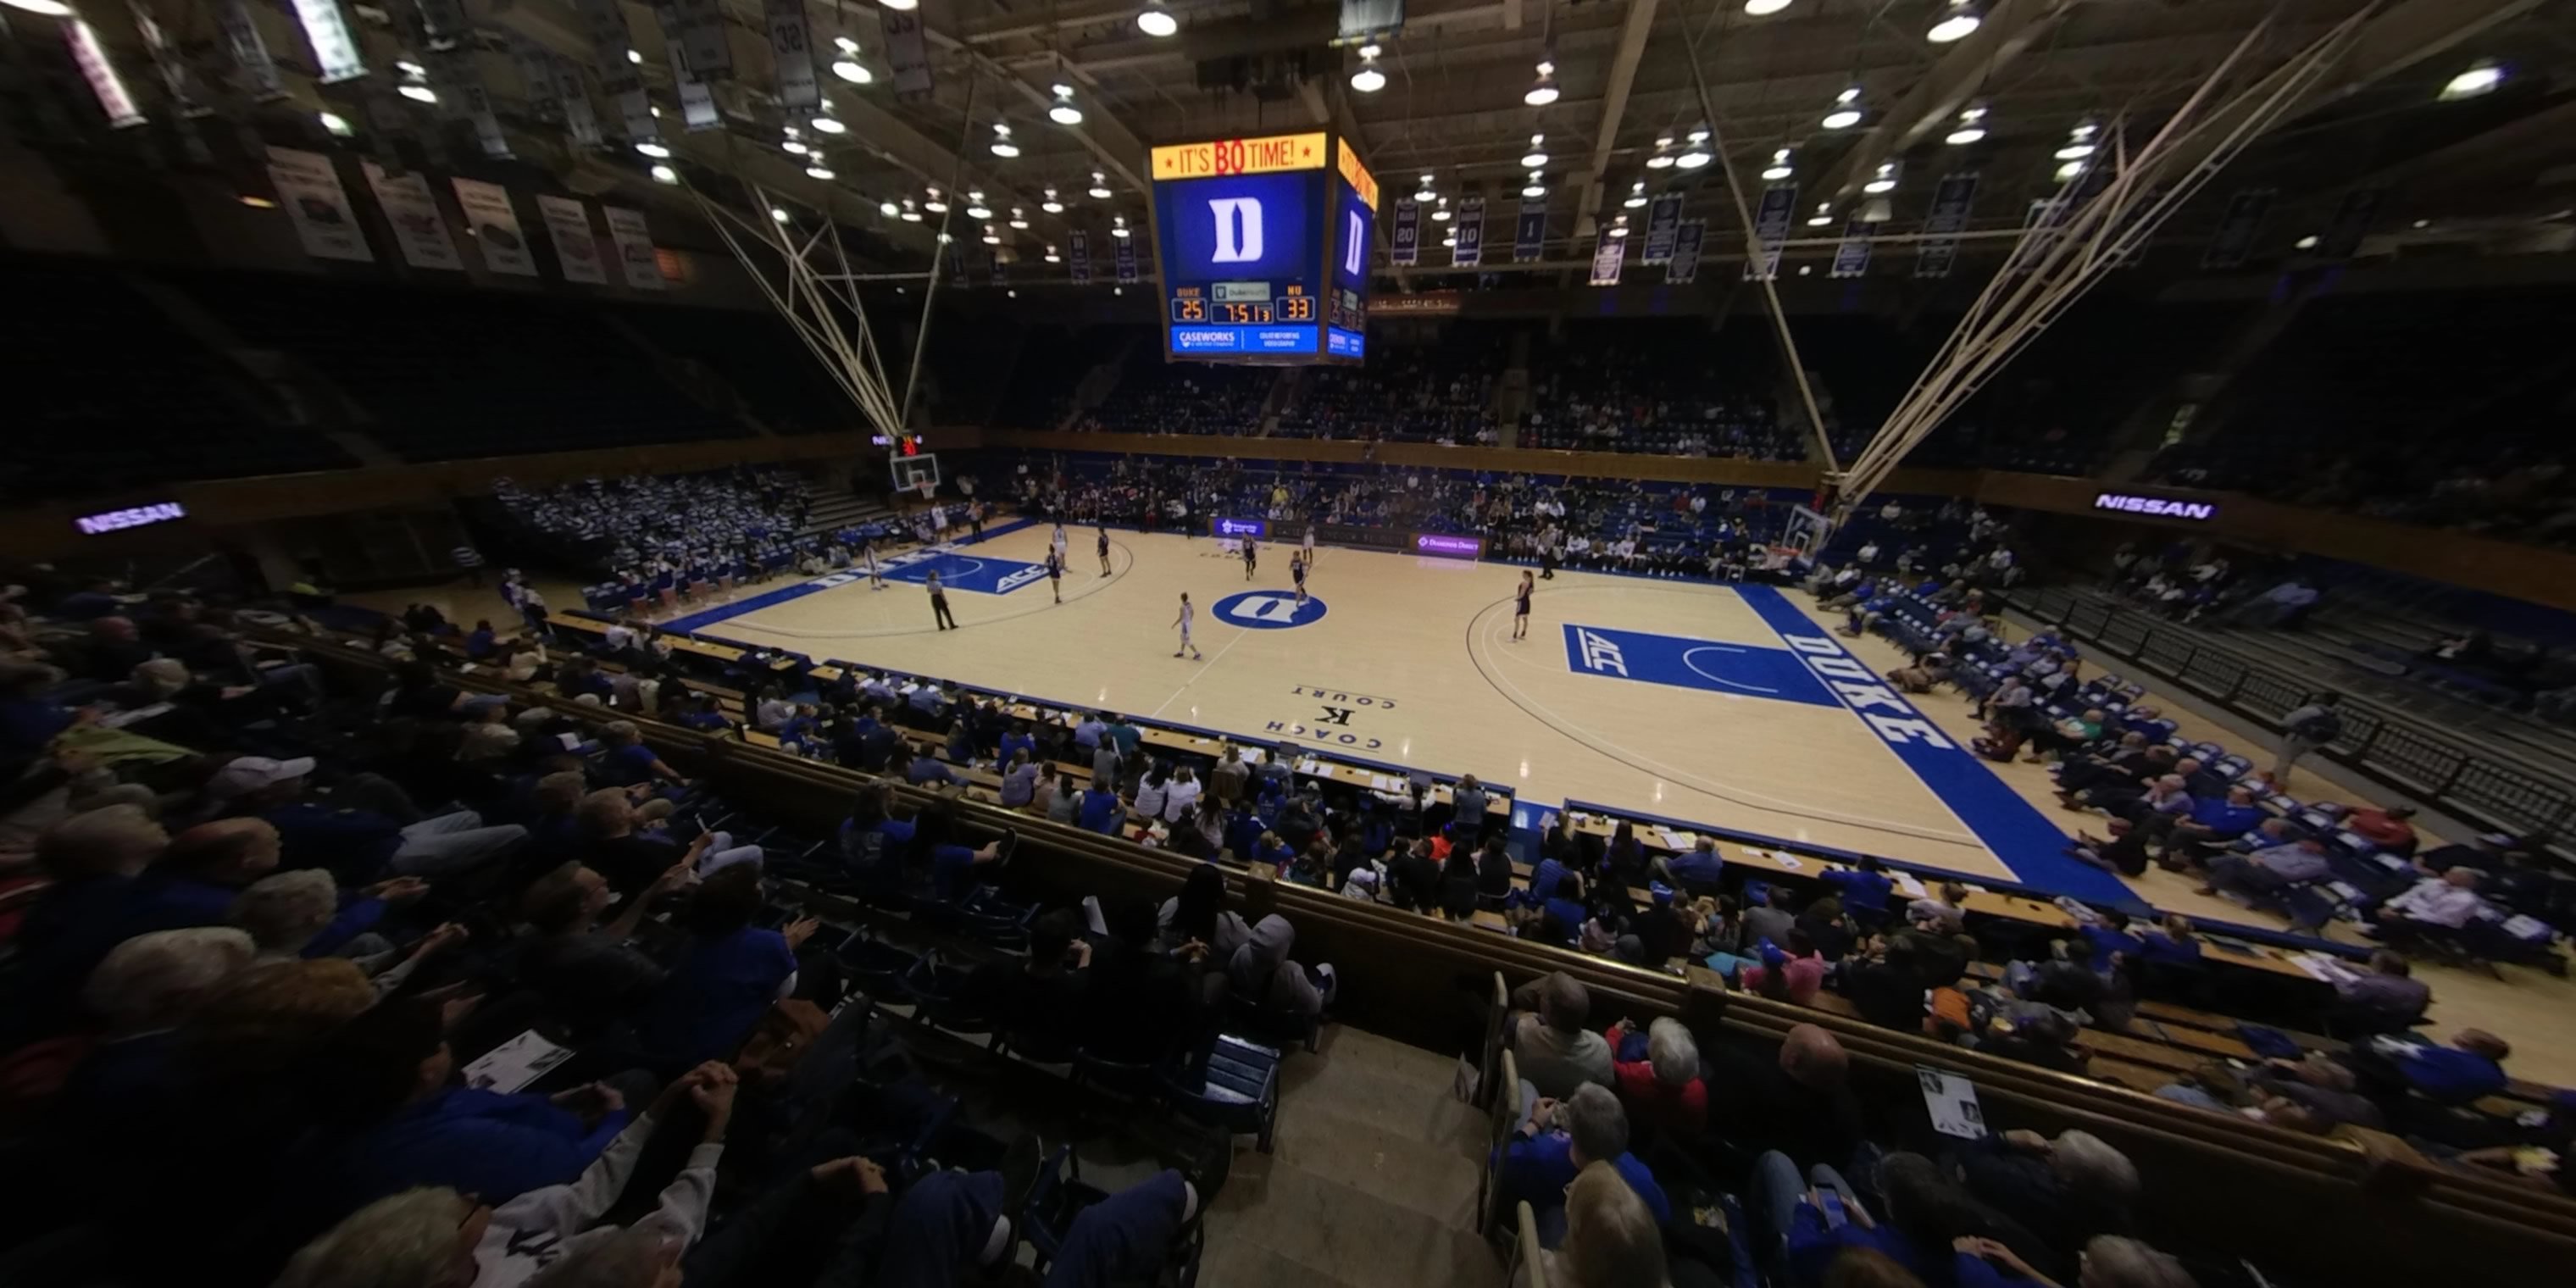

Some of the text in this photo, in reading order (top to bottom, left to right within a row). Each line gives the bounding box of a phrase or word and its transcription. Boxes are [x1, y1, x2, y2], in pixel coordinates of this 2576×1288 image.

[1180, 138, 1295, 176] IT'S BO TIME!
[1208, 197, 1263, 263] D
[1176, 287, 1202, 298] DUKE
[1287, 286, 1302, 297] NU
[1182, 300, 1203, 319] 25
[1287, 298, 1308, 319] 33
[1179, 330, 1235, 343] CASEWORKS
[75, 502, 186, 535] NISSAN
[2095, 493, 2212, 519] NISSAN
[1585, 630, 1629, 678] ACC
[1291, 686, 1396, 710] COURT
[1783, 634, 1956, 750] DUKE
[1314, 705, 1356, 727] K
[1266, 720, 1382, 749] COACH
